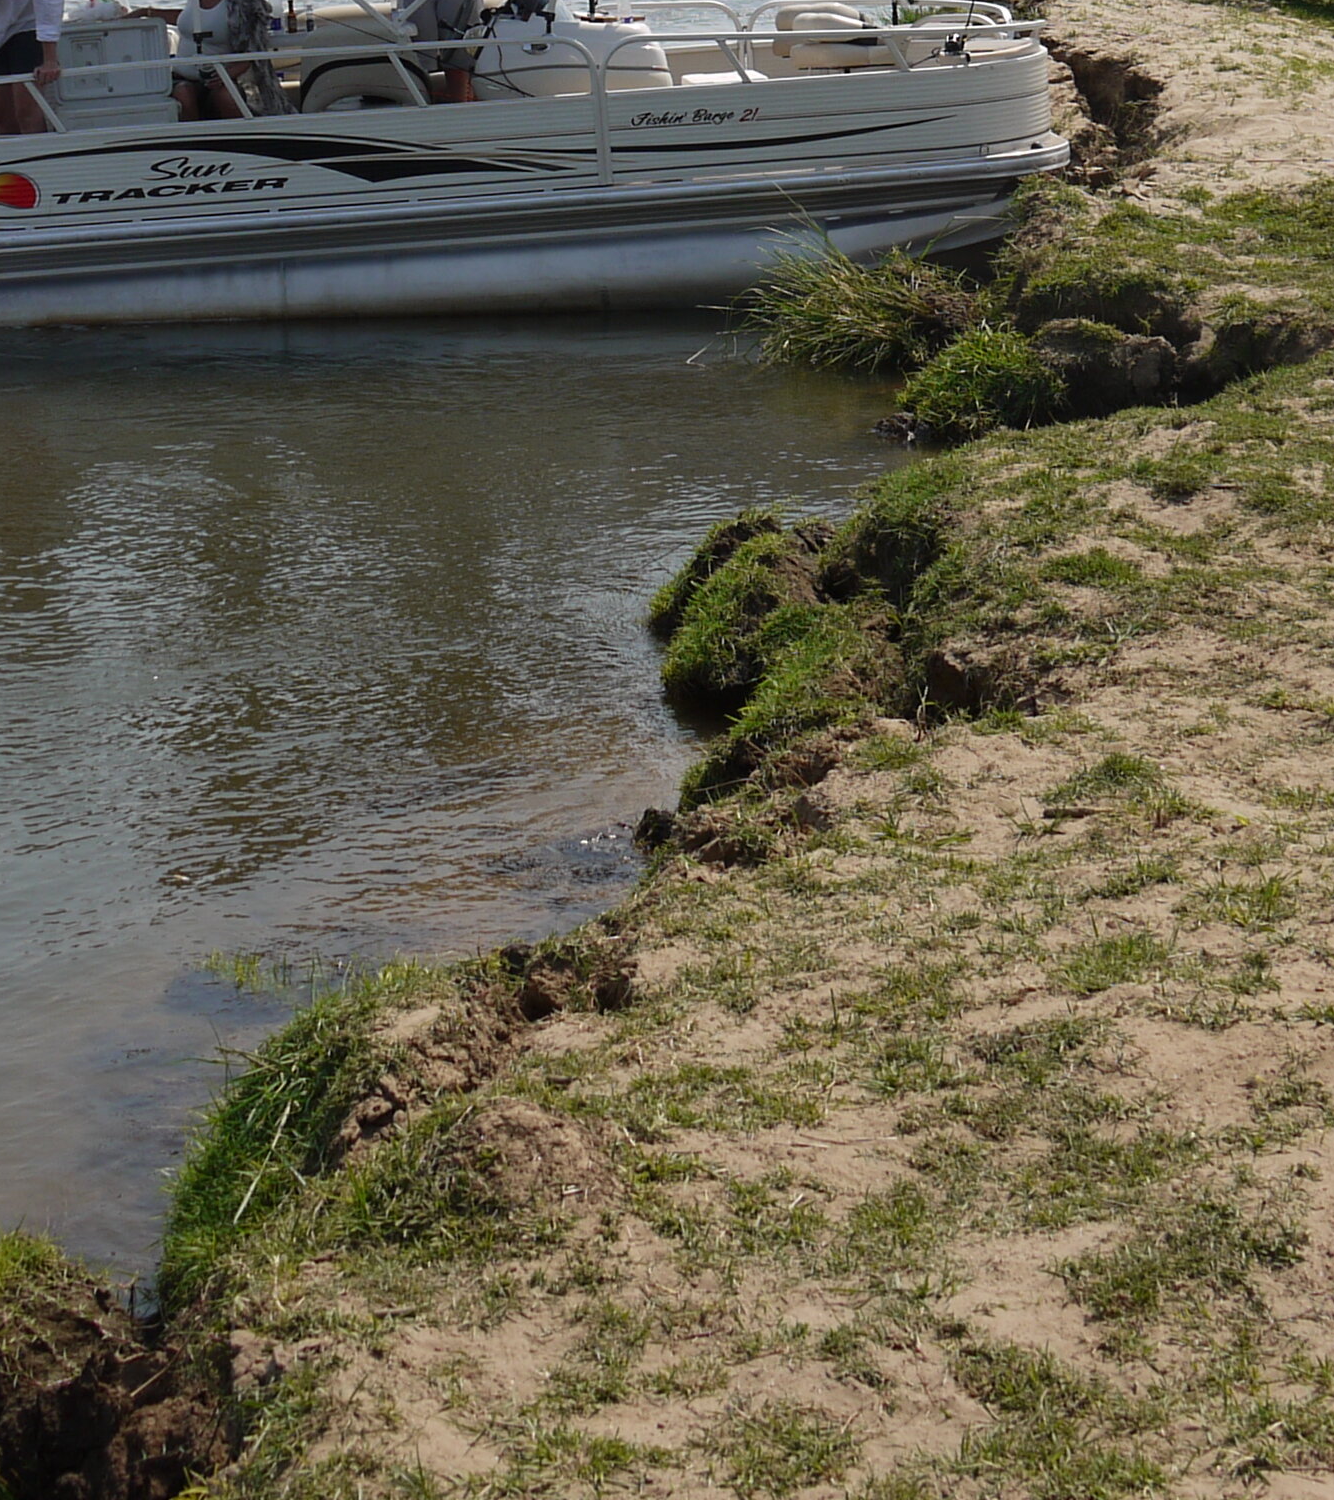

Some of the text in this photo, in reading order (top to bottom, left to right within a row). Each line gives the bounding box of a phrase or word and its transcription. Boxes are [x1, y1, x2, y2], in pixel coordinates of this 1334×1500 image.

[692, 108, 734, 125] Barge
[739, 107, 759, 122] 21
[140, 156, 234, 181] Sun
[52, 177, 289, 205] TRACKER
